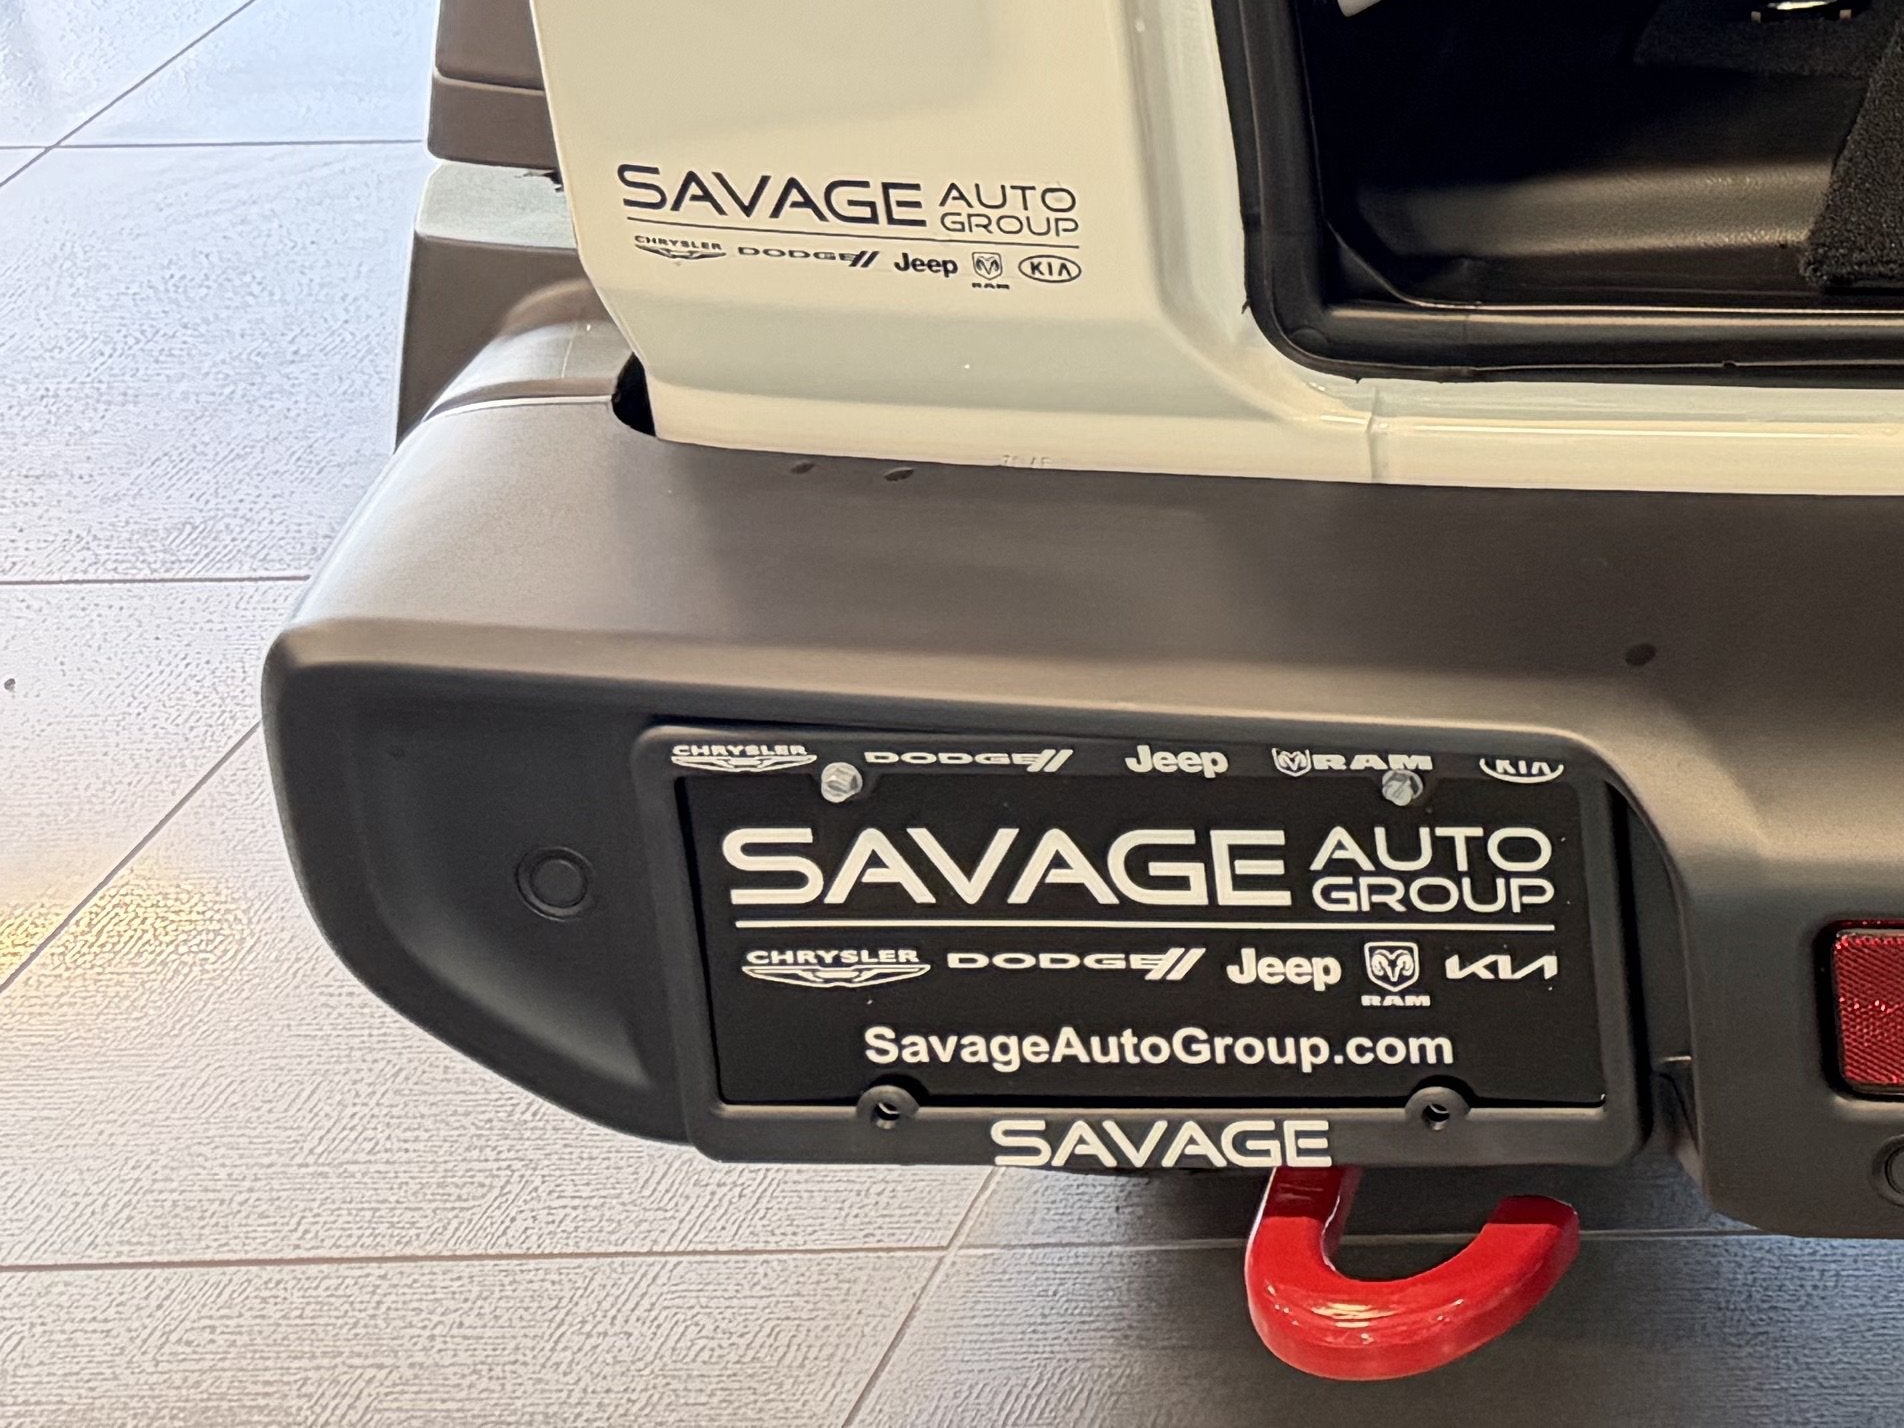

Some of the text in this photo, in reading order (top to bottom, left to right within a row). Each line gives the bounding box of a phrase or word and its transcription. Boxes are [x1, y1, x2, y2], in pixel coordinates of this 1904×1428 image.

[617, 164, 1078, 228] SAVAGE AUTO
[940, 213, 1080, 237] GROUP
[634, 235, 723, 251] CHRYSLER
[738, 246, 859, 262] DODGE
[894, 252, 959, 278] Jeep
[671, 744, 808, 756] CHRYSLER
[864, 751, 1041, 765] DODGE
[1125, 745, 1229, 778] Jeep
[1312, 754, 1433, 771] RAM
[721, 825, 1553, 907] SAVAGE AUTO
[1311, 875, 1556, 913] GROUP
[746, 949, 920, 965] CHRYSLER
[946, 952, 1166, 970] DODGE
[1226, 947, 1342, 991] Jeep
[1361, 994, 1431, 1007] RAM
[864, 1026, 1454, 1072] SavageAutoGroup.com
[991, 1119, 1333, 1168] SAVAGE
